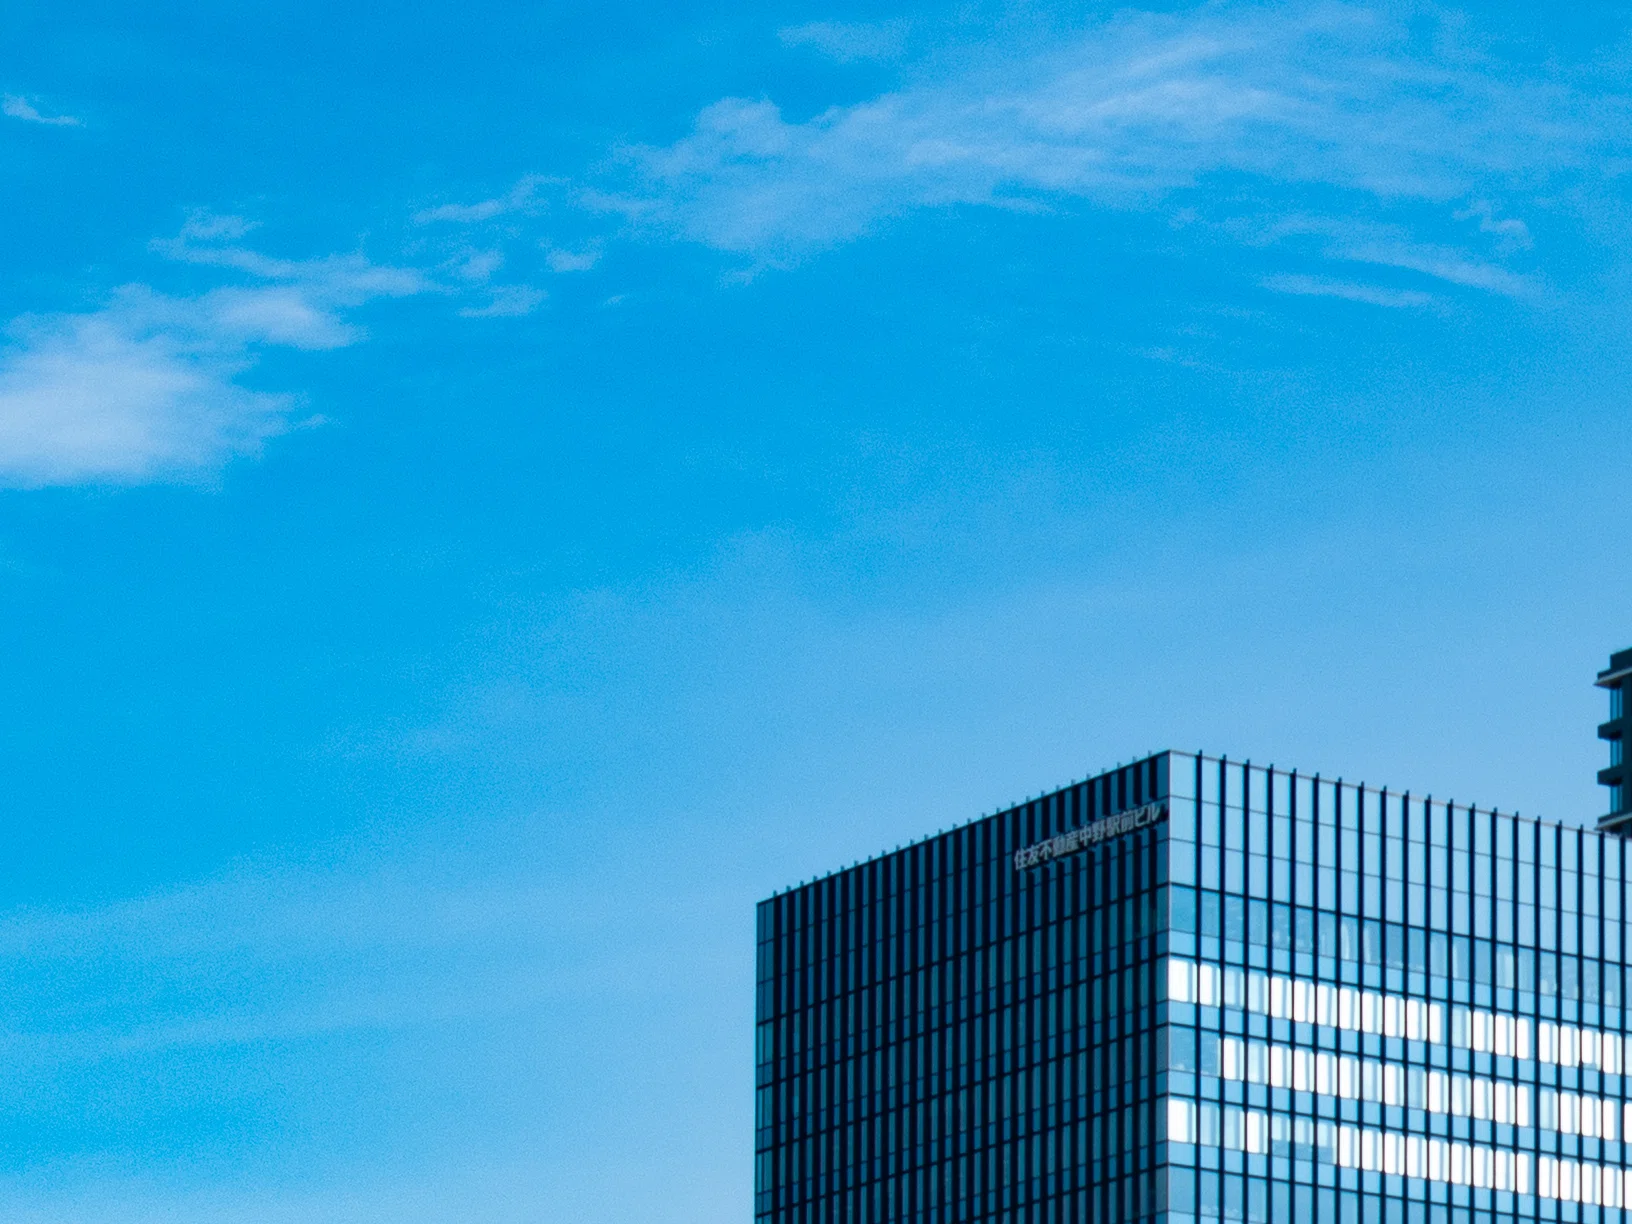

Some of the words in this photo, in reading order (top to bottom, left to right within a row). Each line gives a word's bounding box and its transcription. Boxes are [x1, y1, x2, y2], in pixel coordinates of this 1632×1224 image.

[1013, 803, 1161, 871] 住友不動産中野駅前ビル
